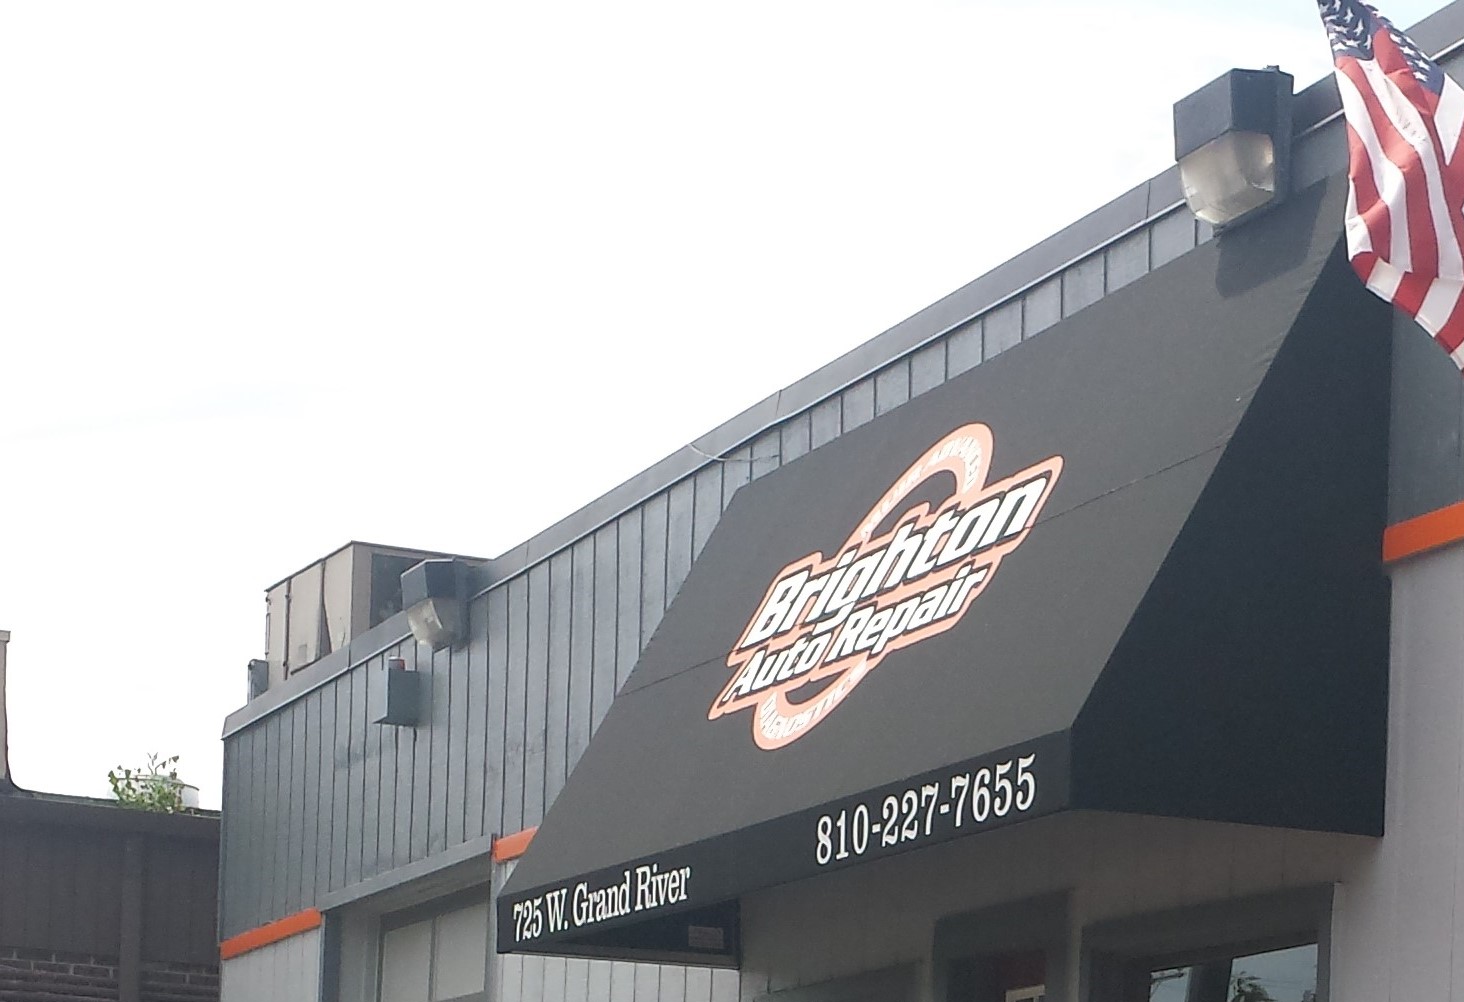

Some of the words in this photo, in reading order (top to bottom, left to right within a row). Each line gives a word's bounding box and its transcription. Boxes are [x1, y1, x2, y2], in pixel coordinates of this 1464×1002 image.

[740, 477, 1047, 648] Brighton
[722, 632, 832, 703] Auto
[827, 565, 987, 662] Repair
[816, 753, 1036, 865] 810-227-7655
[513, 897, 543, 942] 725
[546, 888, 568, 932] W.
[573, 870, 631, 926] Grand
[635, 863, 691, 911] River
